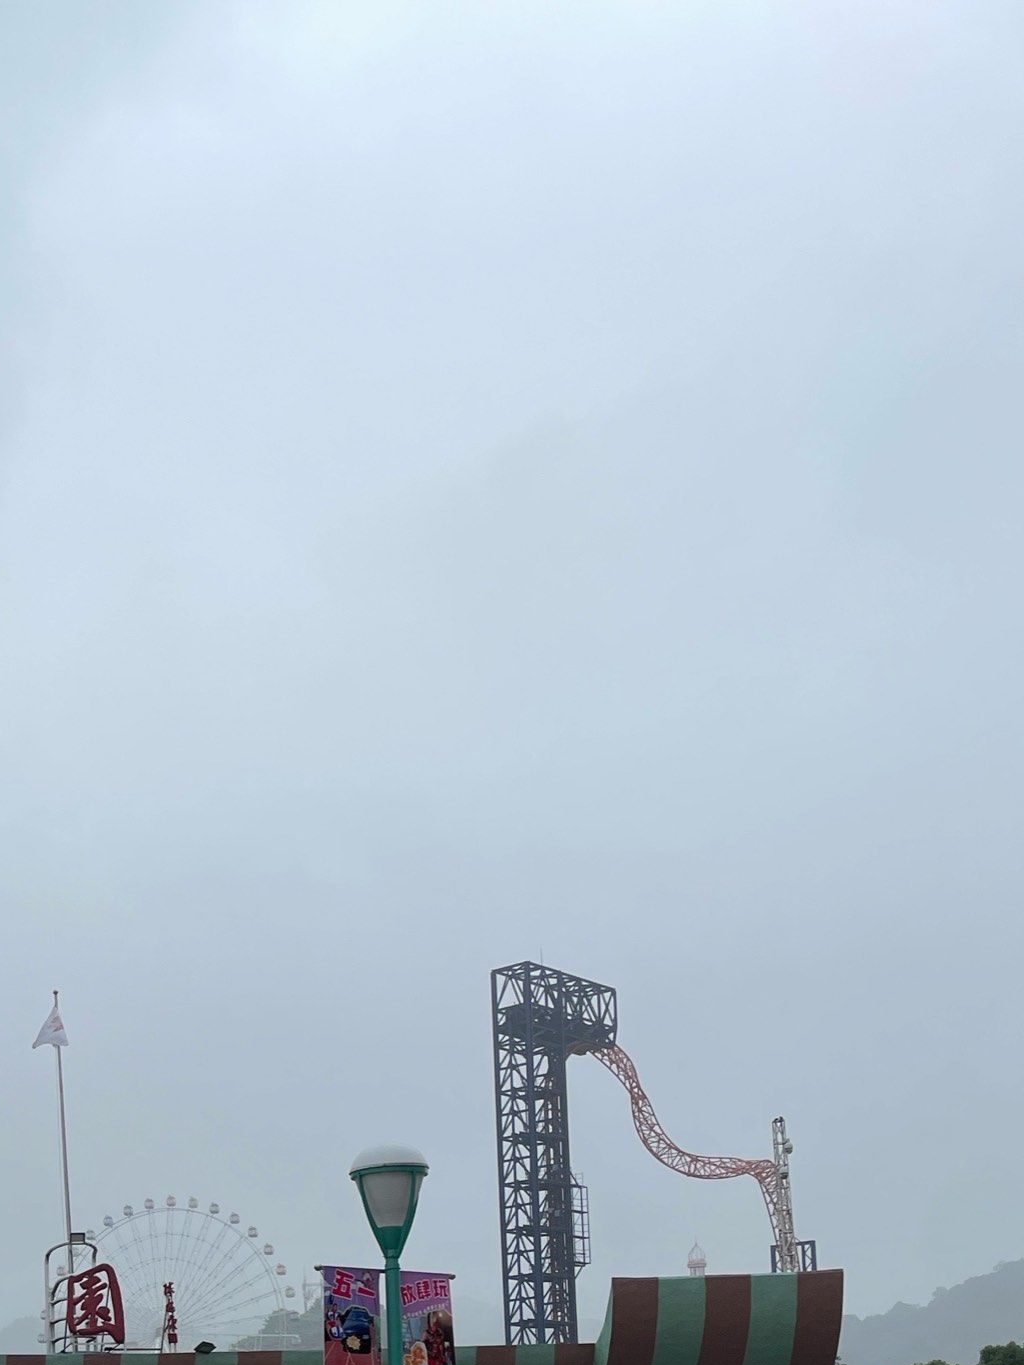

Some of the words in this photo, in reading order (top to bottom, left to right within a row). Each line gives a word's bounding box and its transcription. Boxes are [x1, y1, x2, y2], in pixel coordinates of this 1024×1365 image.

[331, 1269, 376, 1299] 五一
[400, 1279, 449, 1306] 放肆玩
